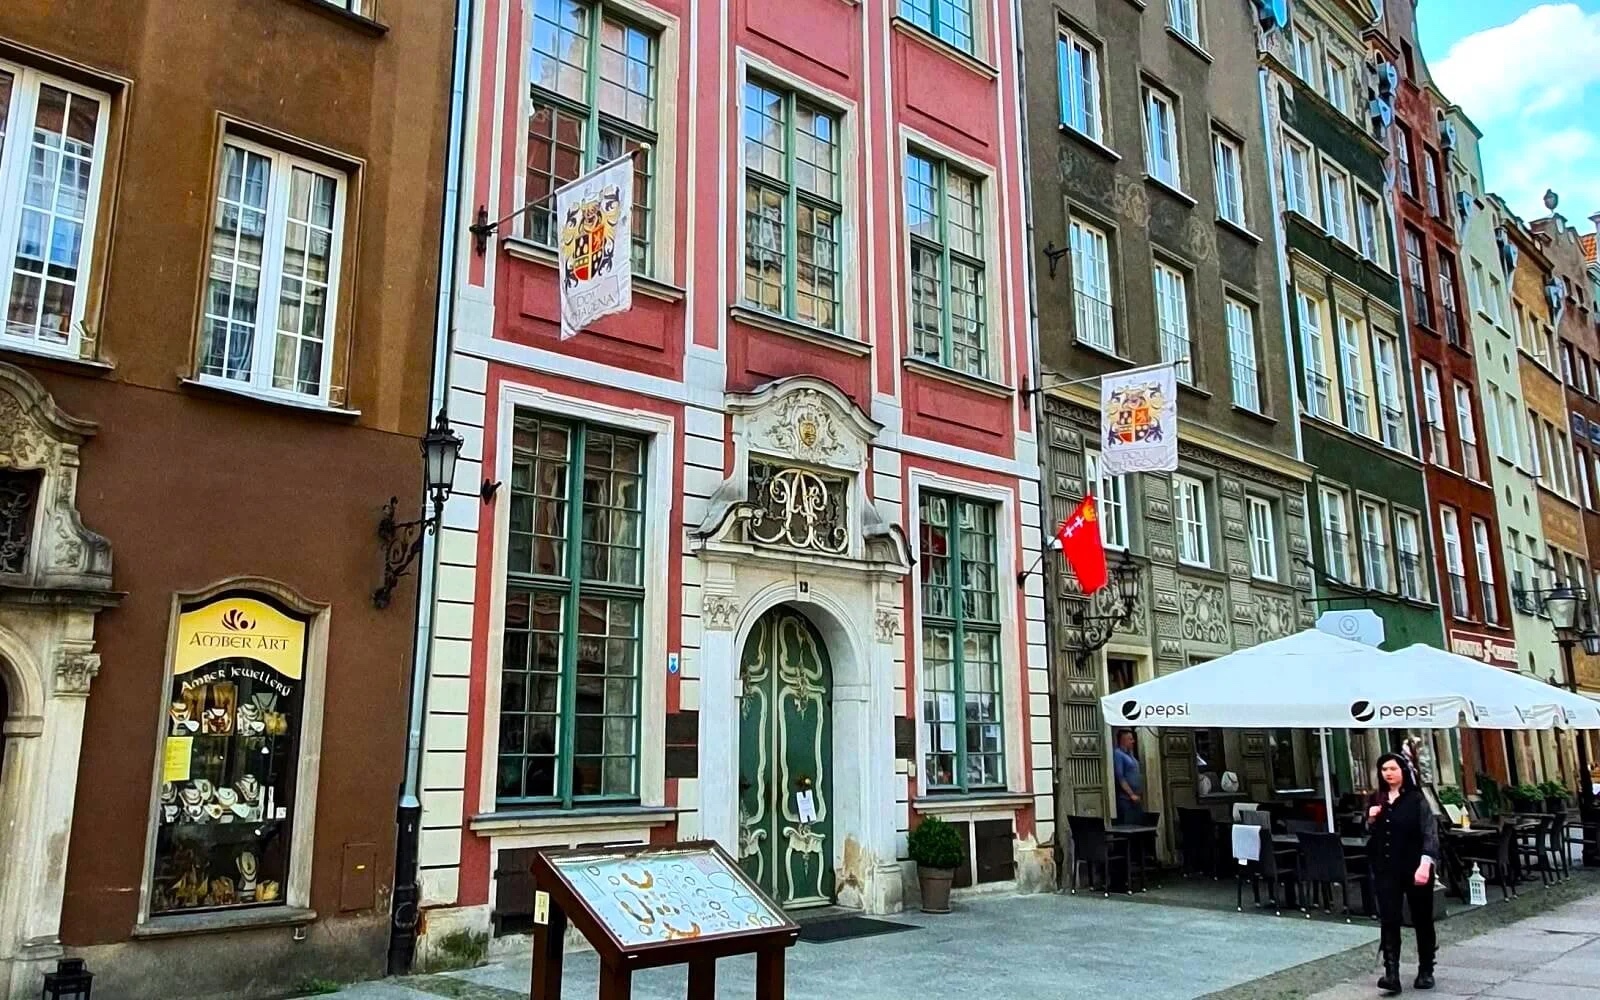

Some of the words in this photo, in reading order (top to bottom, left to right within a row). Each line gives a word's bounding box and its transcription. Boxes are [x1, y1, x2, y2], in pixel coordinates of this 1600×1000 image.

[189, 632, 252, 648] AMBER
[257, 635, 290, 650] ART
[1145, 702, 1190, 718] pepsi
[1379, 703, 1435, 720] pepsi
